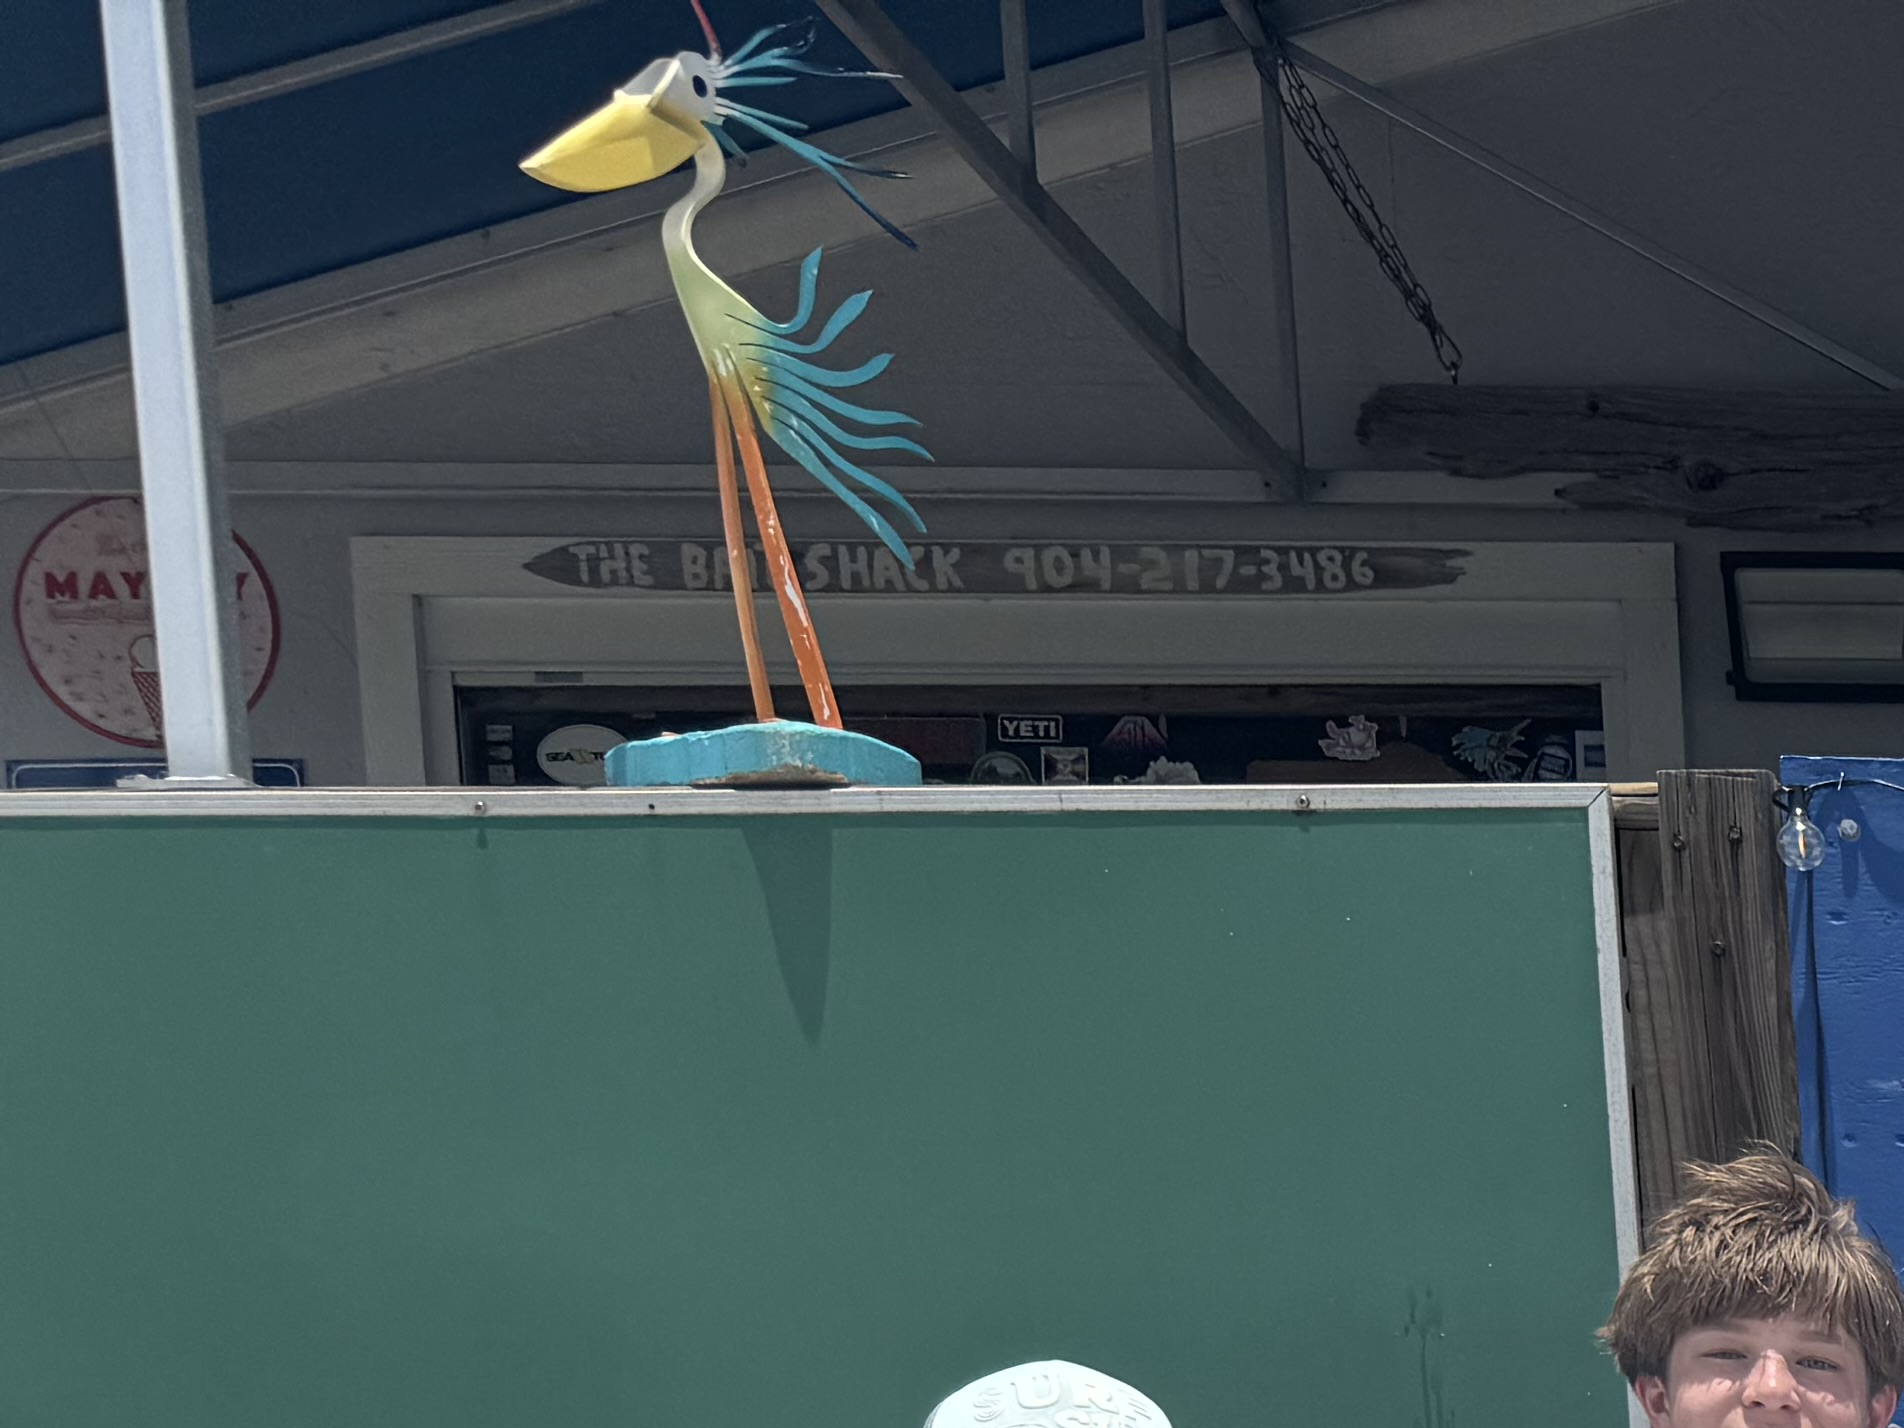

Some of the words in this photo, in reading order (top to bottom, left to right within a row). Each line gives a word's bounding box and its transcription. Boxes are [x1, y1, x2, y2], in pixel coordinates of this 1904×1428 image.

[568, 543, 654, 584] THE
[803, 542, 965, 591] SHACK
[1003, 545, 1376, 592] 904-217-3486
[1002, 719, 1057, 738] YETI
